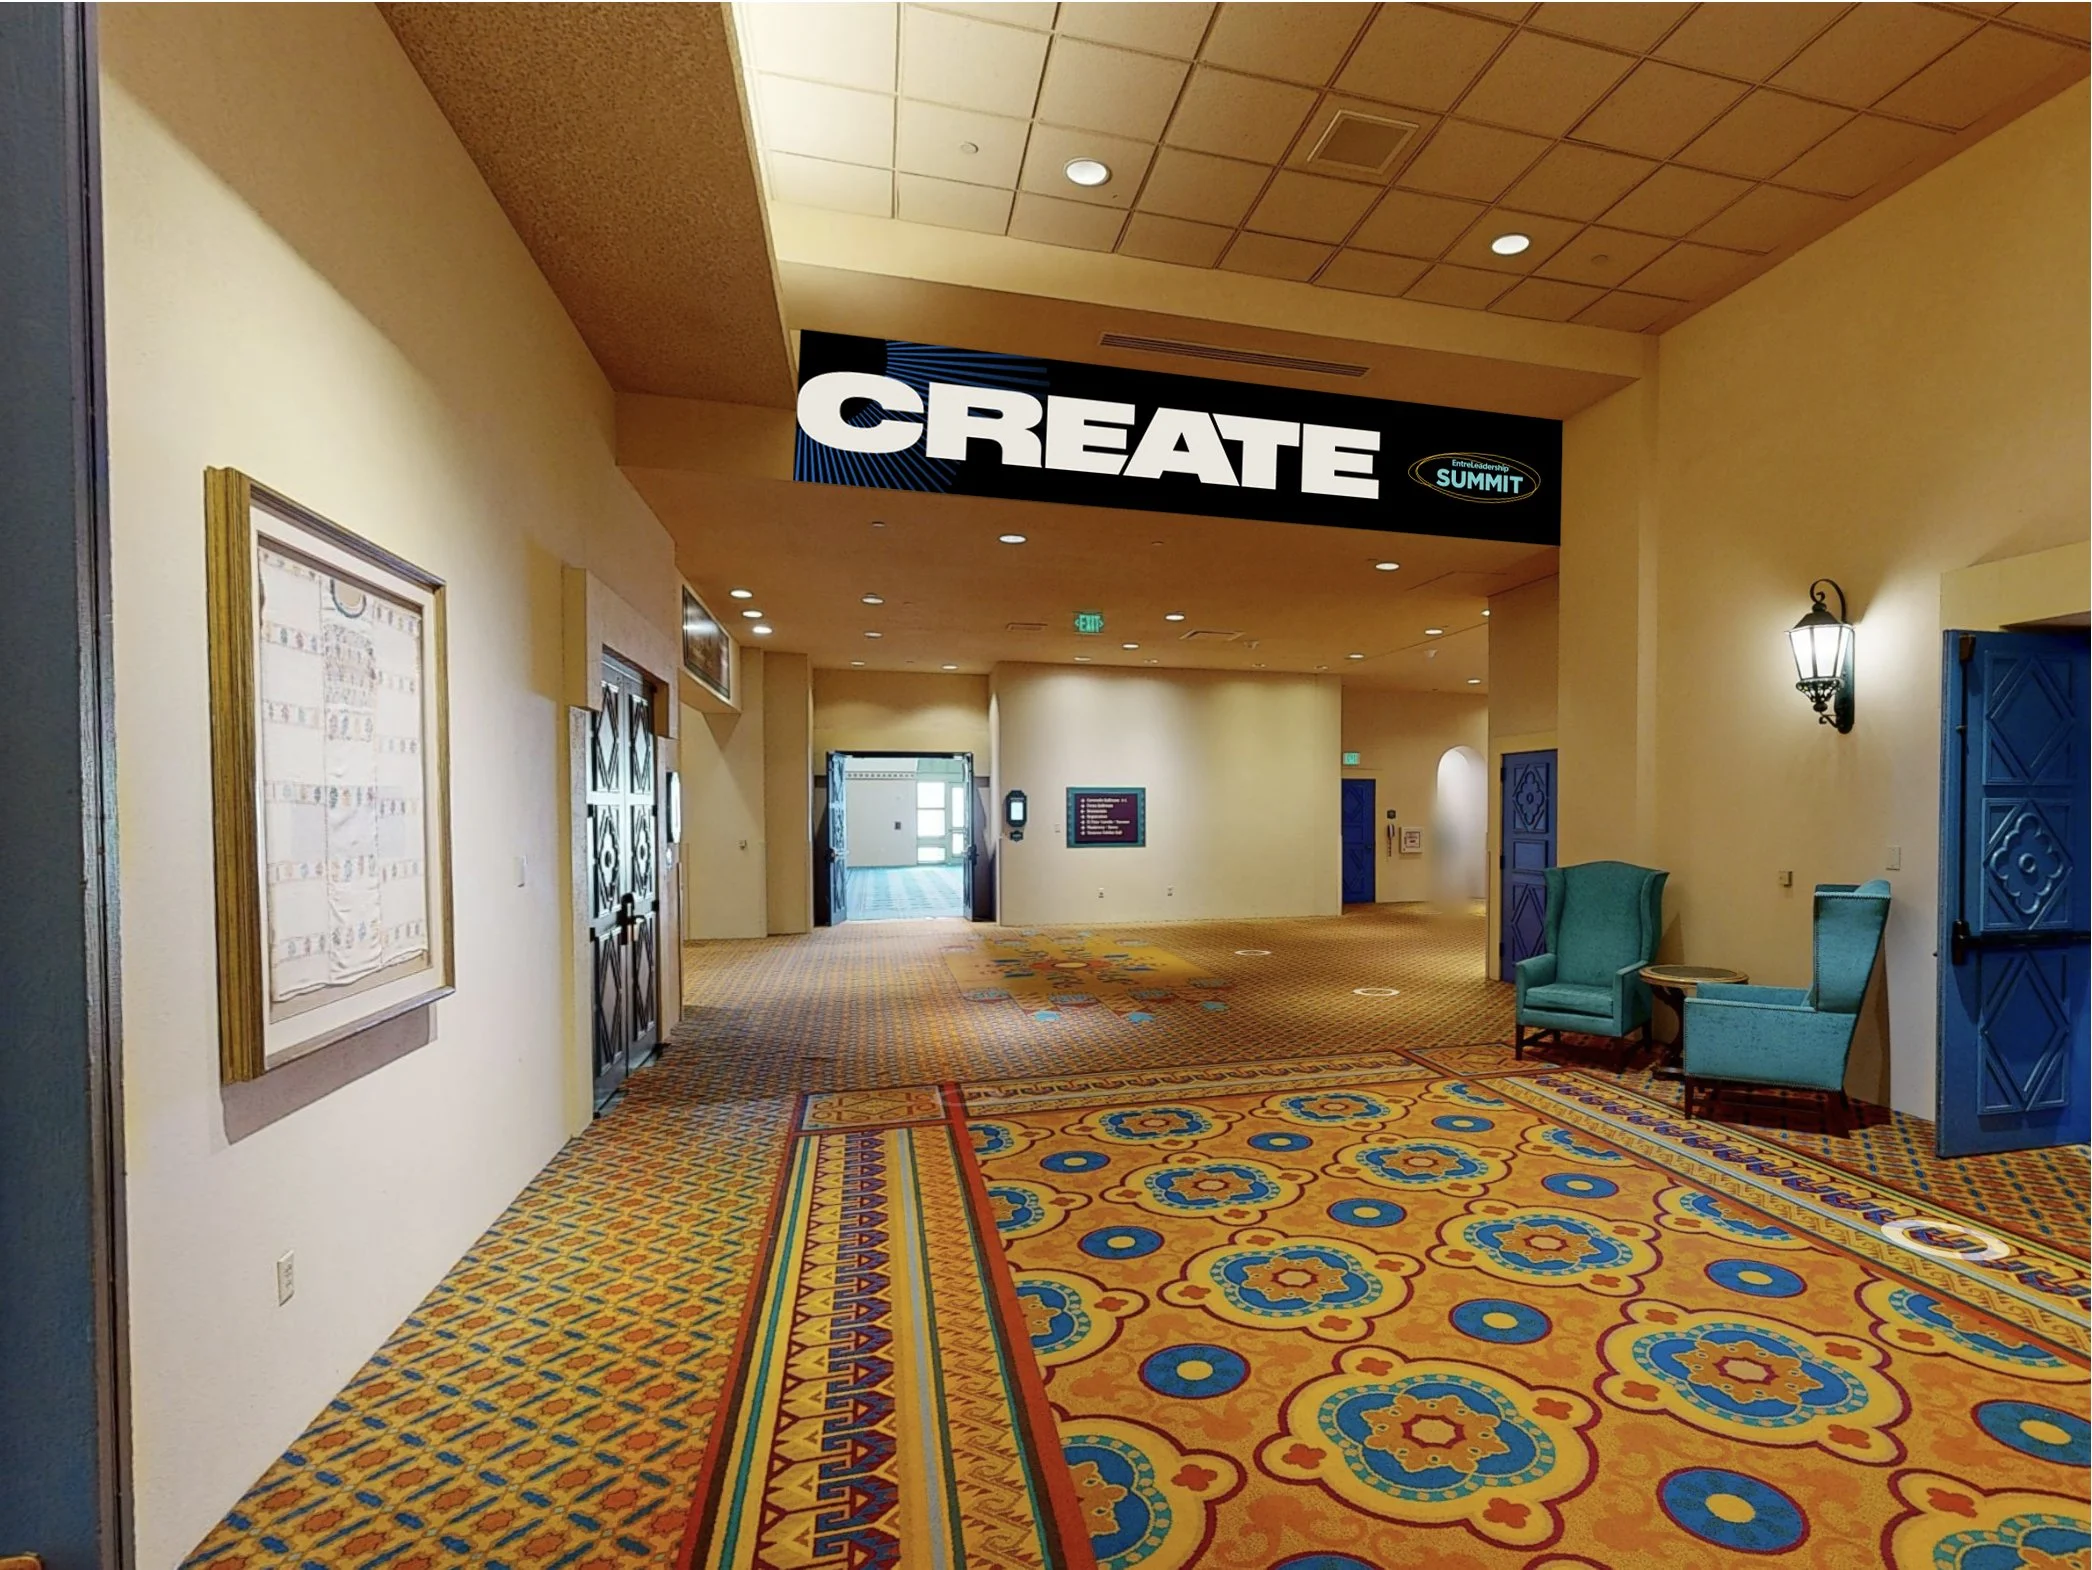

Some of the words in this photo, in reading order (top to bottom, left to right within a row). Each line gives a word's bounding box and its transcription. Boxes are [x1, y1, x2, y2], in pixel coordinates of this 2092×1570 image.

[797, 371, 1381, 499] CREATE
[1452, 459, 1509, 472] EntreLeadership
[1436, 468, 1523, 494] SUMMIT
[1079, 614, 1101, 632] EXIT
